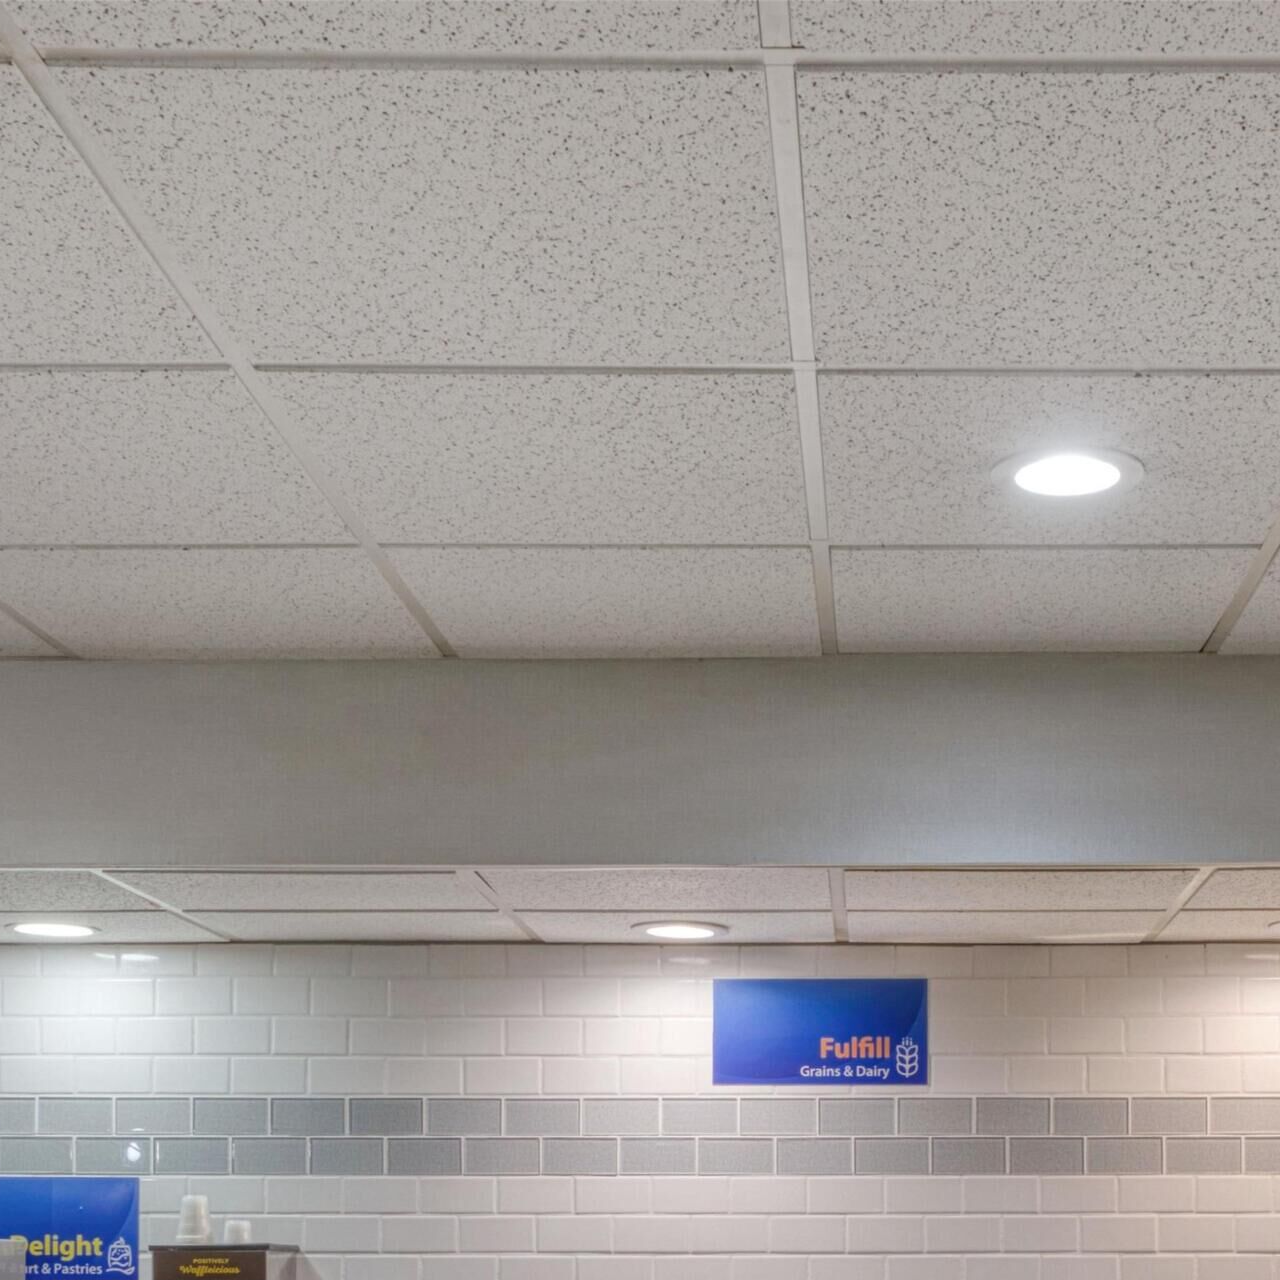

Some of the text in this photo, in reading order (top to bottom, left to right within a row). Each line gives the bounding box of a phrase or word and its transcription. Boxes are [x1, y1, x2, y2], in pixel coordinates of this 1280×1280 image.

[819, 1036, 891, 1059] Fulfill
[800, 1065, 890, 1079] Grains & Dairy
[41, 1263, 51, 1275] &
[54, 1263, 102, 1275] Pastries
